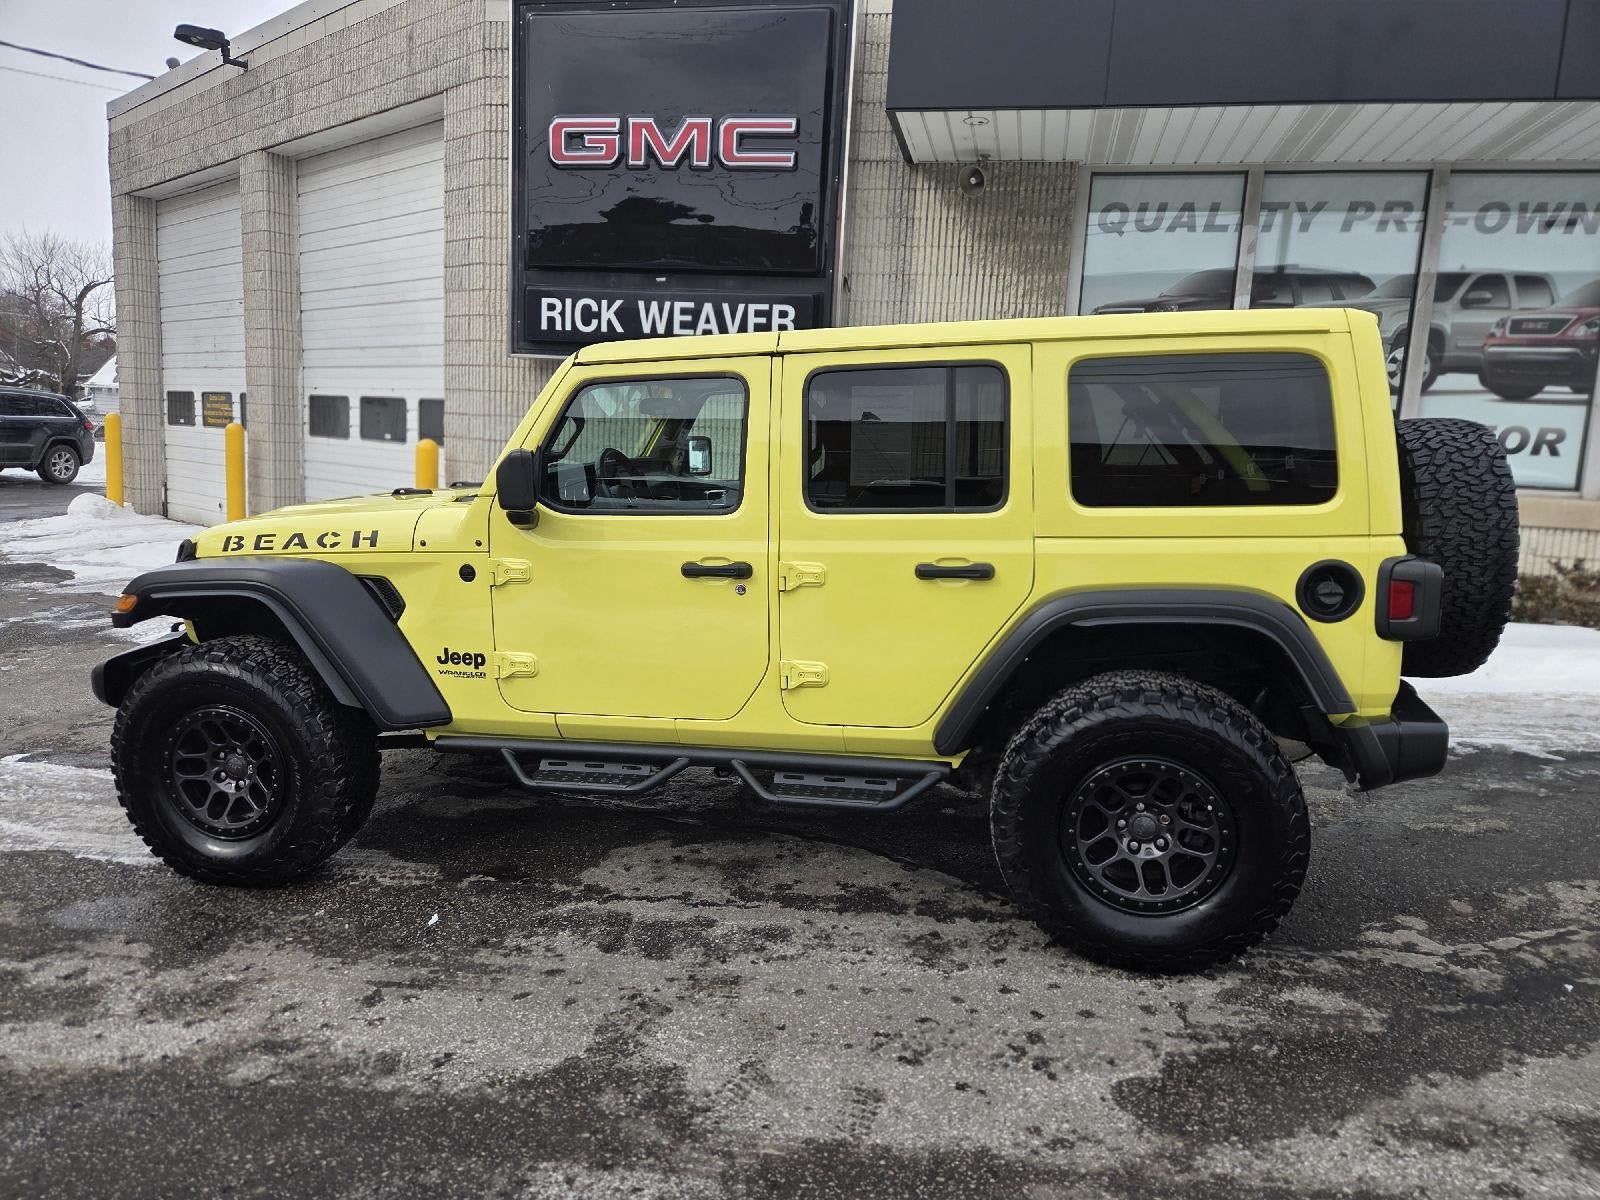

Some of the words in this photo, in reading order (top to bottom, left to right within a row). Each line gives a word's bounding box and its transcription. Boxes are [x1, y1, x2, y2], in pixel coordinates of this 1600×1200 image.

[548, 115, 798, 168] GMC
[1340, 200, 1600, 235] PR-OWN
[540, 297, 625, 333] RICK
[638, 300, 797, 336] WEAVER
[1486, 425, 1567, 457] OR
[222, 529, 379, 553] BEACH
[436, 647, 486, 670] Jeep
